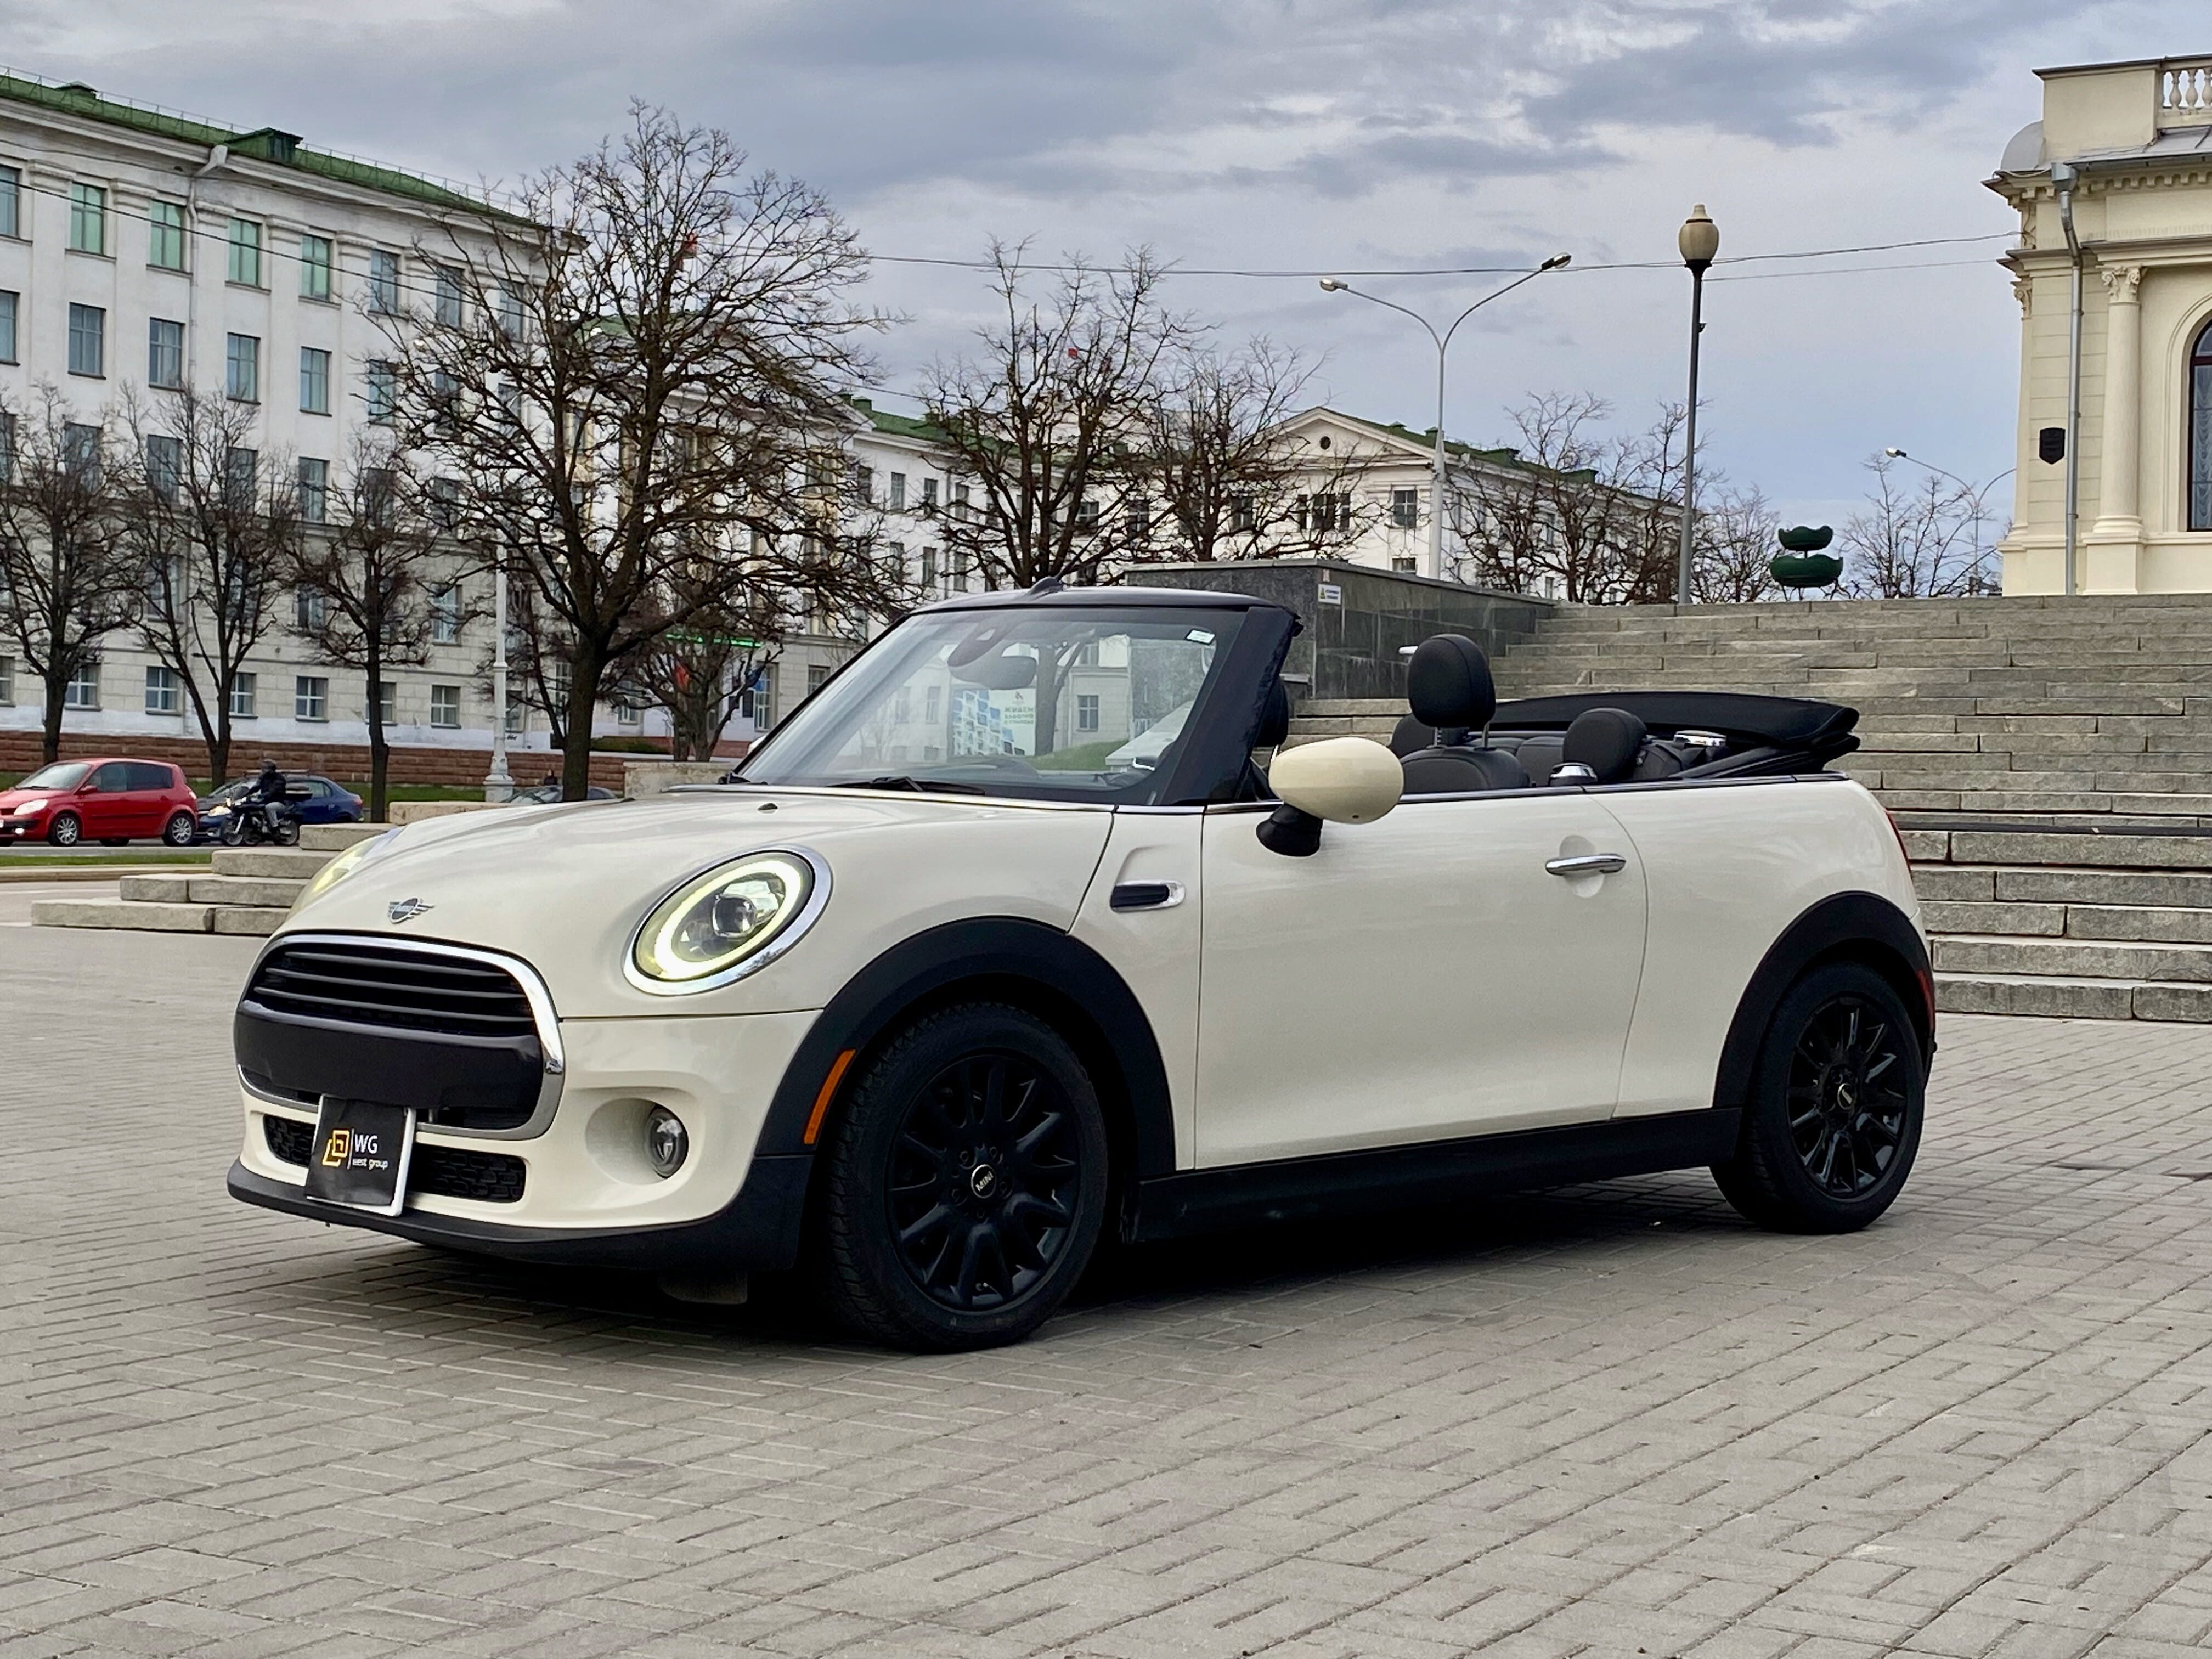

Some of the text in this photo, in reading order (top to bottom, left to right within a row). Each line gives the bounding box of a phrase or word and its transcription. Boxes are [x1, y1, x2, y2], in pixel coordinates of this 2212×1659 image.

[355, 1134, 377, 1154] WG
[369, 1159, 388, 1170] group
[975, 1171, 994, 1192] MINI
